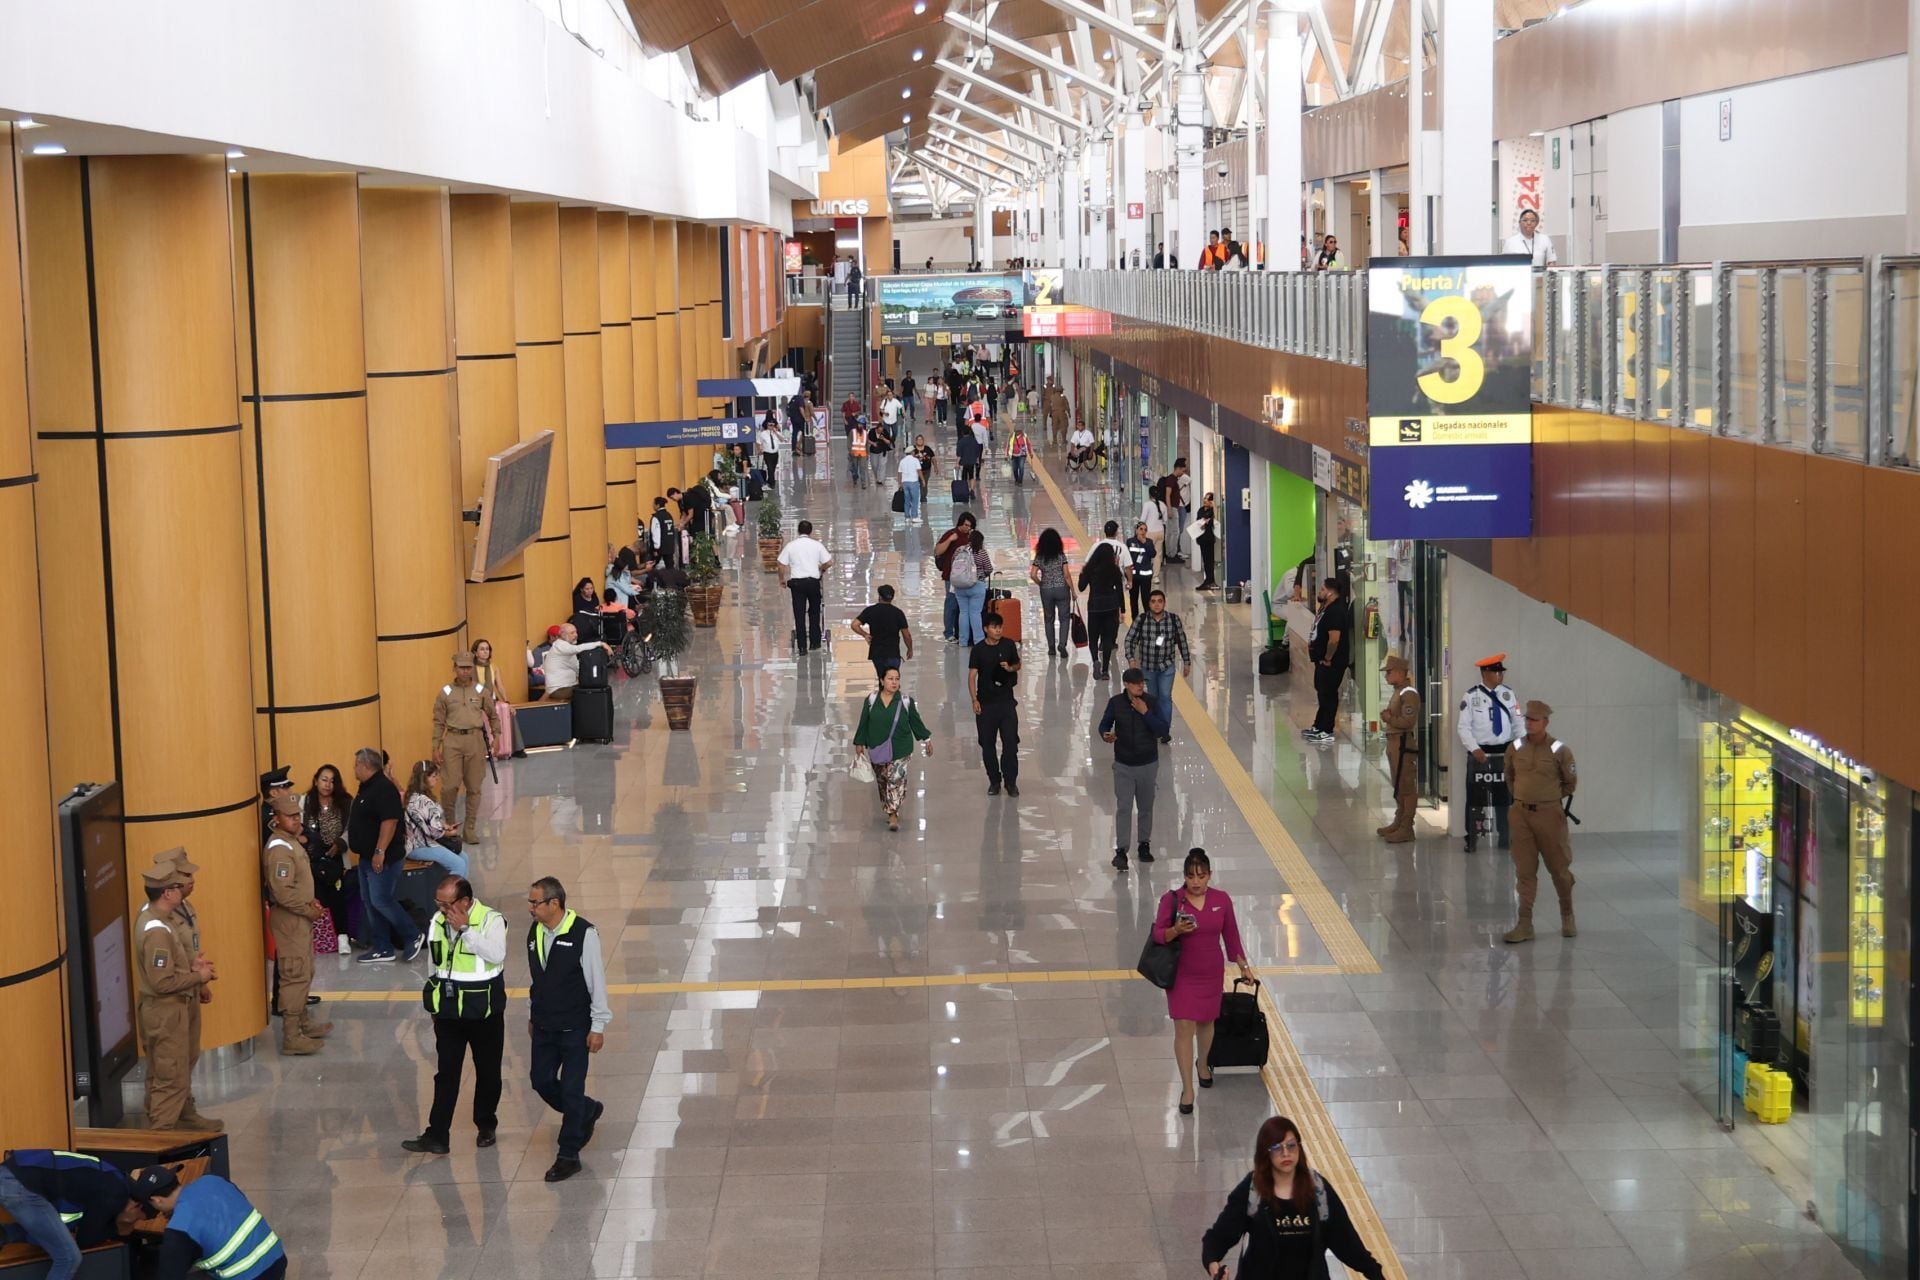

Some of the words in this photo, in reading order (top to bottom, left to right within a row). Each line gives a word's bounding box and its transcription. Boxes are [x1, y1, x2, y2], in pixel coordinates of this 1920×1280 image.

[1035, 275, 1052, 305] 2
[1401, 274, 1453, 290] Puerta
[918, 335, 925, 343] A
[1417, 295, 1485, 404] 3
[1432, 421, 1466, 431] Llegadas
[1467, 420, 1508, 430] nacionales
